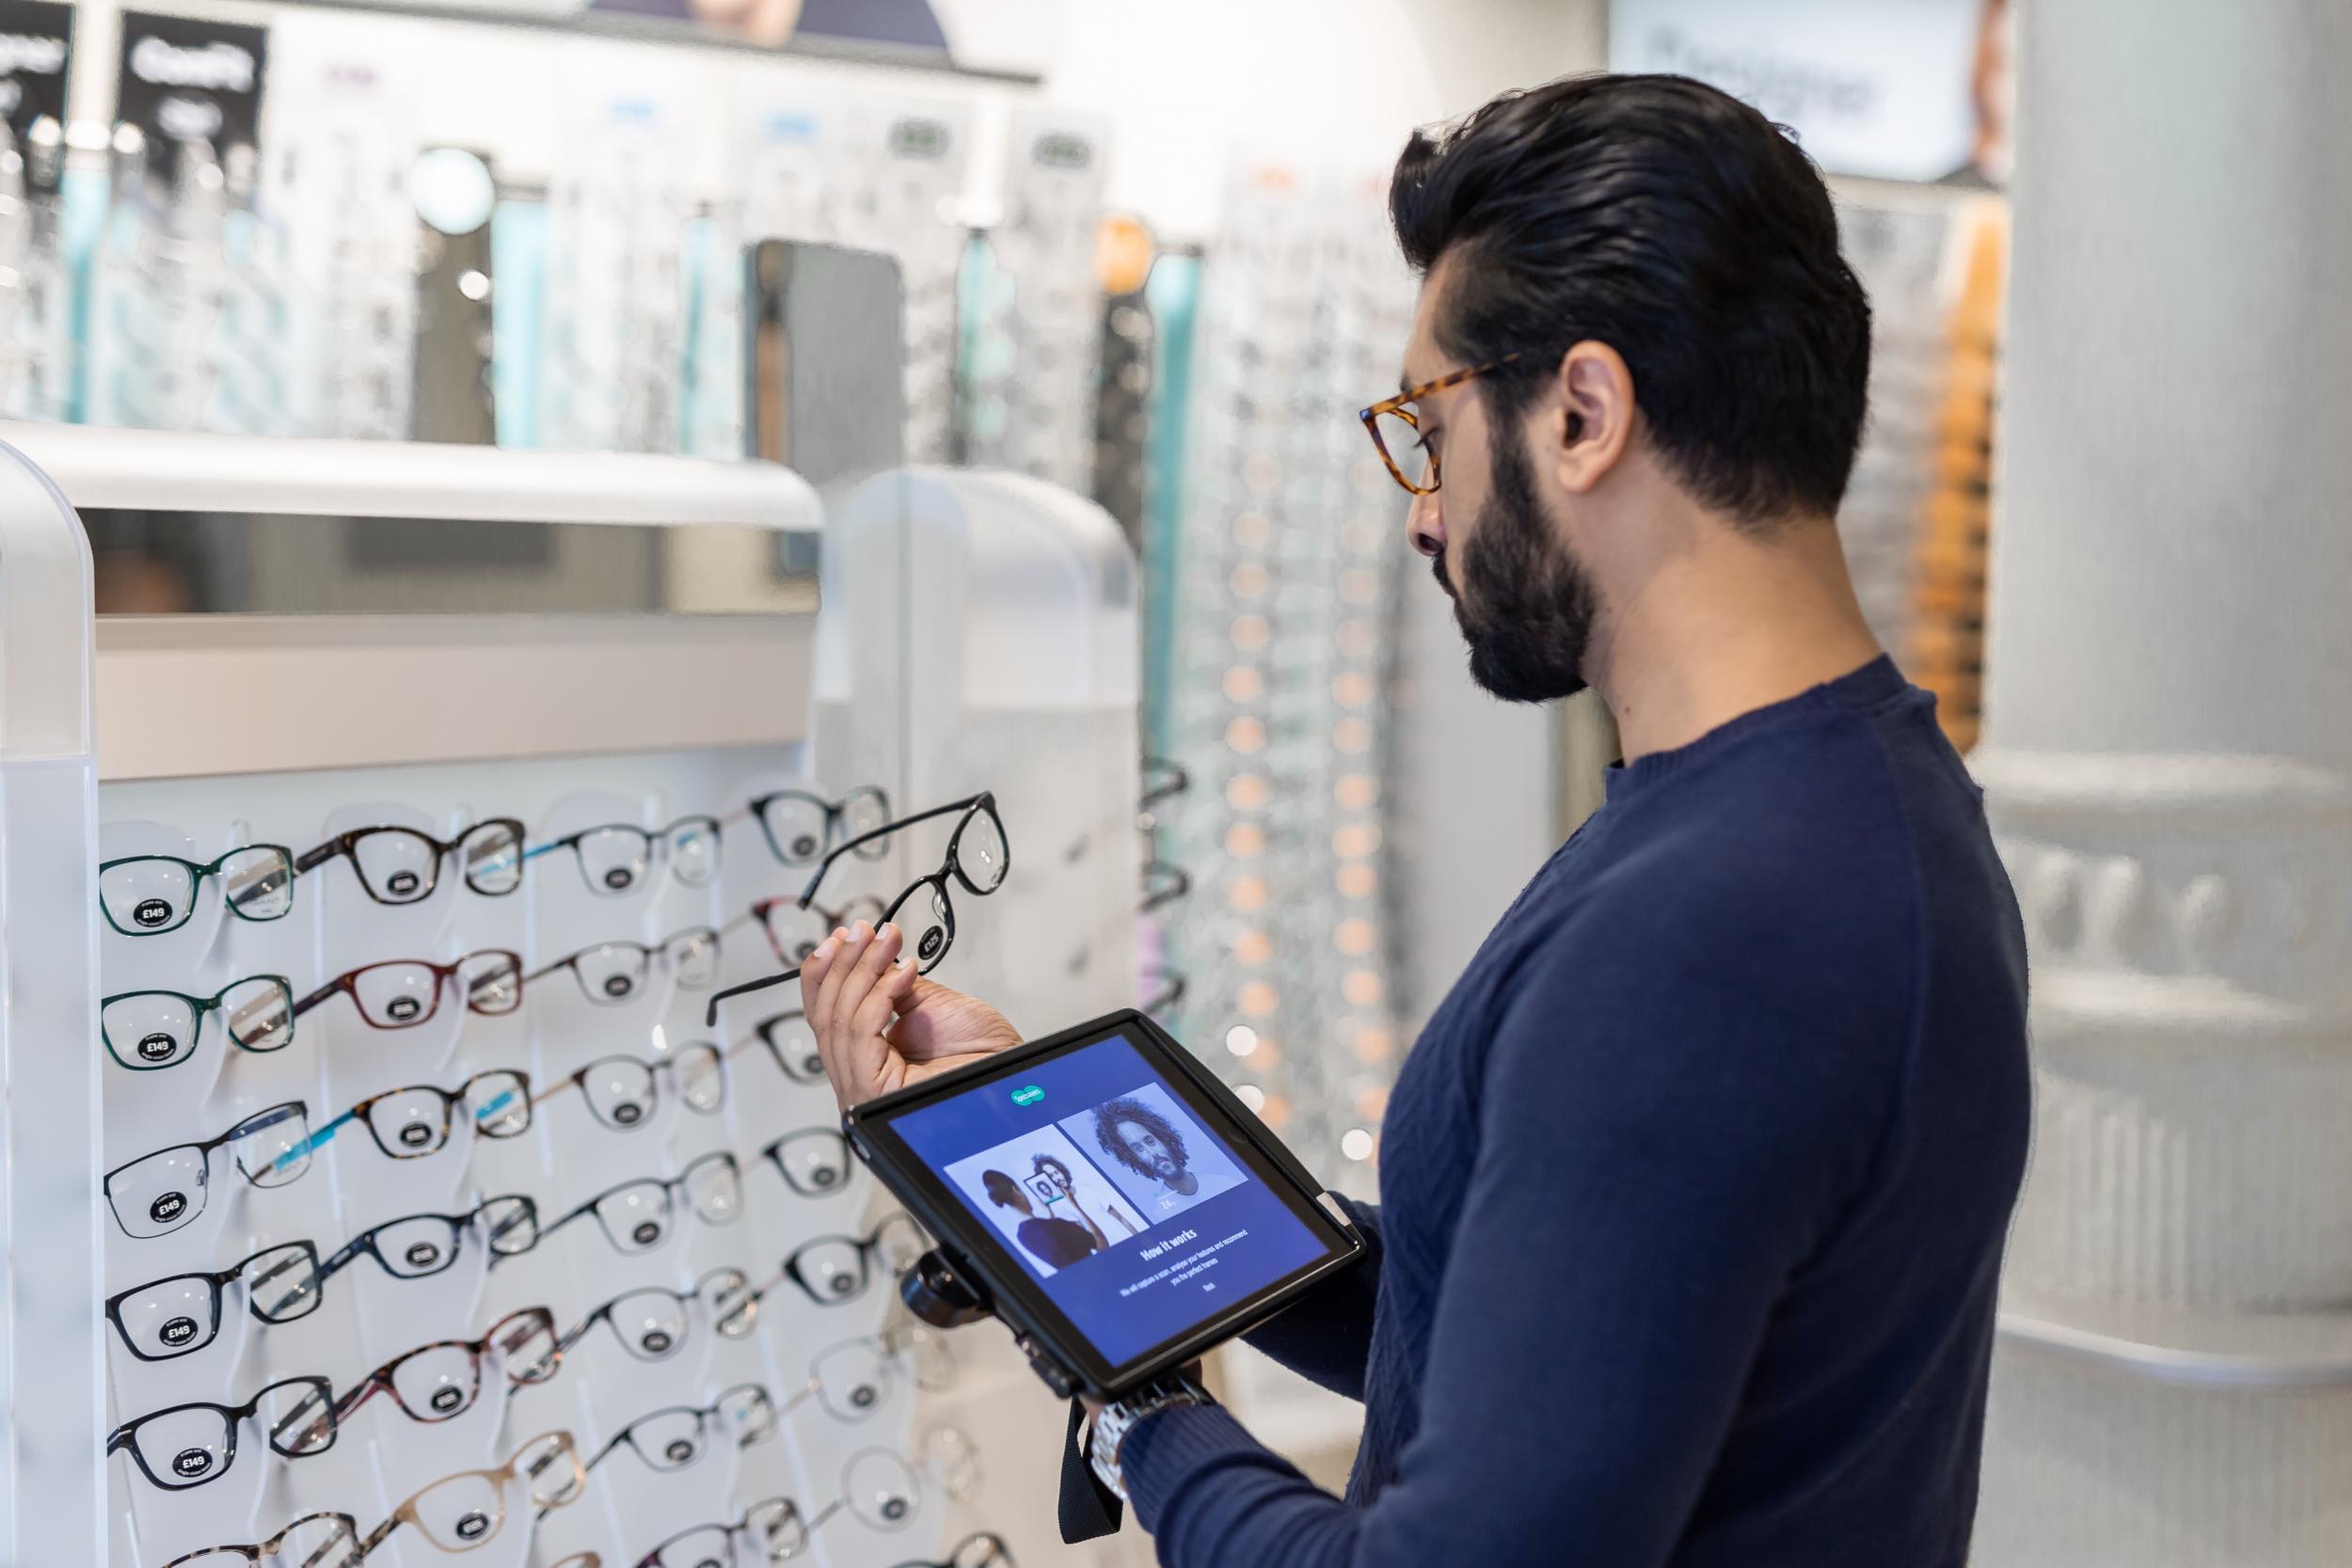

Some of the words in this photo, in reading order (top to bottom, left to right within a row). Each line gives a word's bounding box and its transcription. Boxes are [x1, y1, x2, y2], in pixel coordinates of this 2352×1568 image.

[143, 907, 165, 919] £149
[147, 1040, 168, 1053] £149
[159, 1199, 180, 1215] £149
[1139, 1246, 1164, 1261] How
[1159, 1241, 1172, 1252] it
[1169, 1228, 1198, 1247] works
[168, 1324, 190, 1338] £149
[183, 1456, 205, 1469] £149
